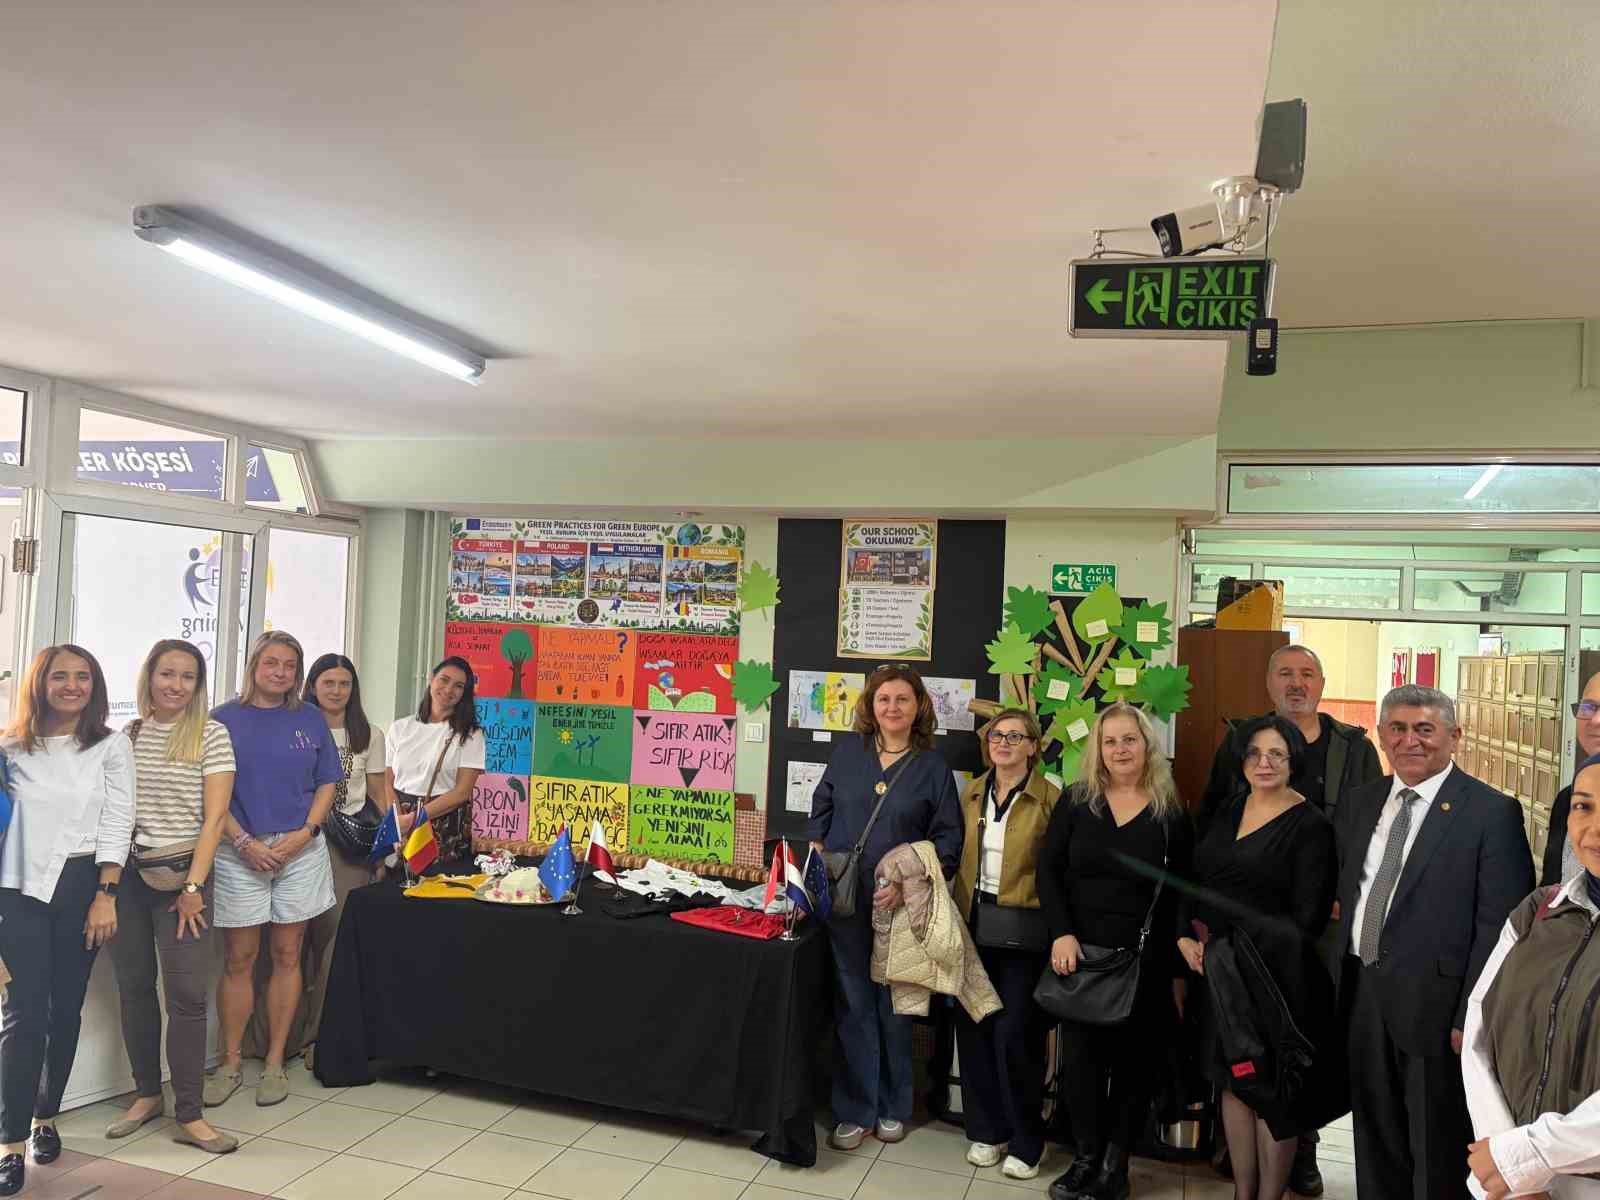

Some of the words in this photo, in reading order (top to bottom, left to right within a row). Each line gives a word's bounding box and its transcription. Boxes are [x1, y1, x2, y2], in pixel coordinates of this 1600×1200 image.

[1178, 266, 1262, 296] EXIT
[111, 446, 194, 479] KÖŞESİ
[527, 520, 552, 529] GREEN
[554, 520, 592, 531] PRACTICES
[593, 522, 606, 531] FOR
[608, 522, 632, 532] GREEN
[634, 522, 659, 532] EUROPE
[861, 527, 880, 536] OUR
[882, 527, 920, 536] SCHOOL
[865, 537, 914, 545] OKULUMUZ
[618, 545, 657, 554] NETHERLANDS
[652, 722, 689, 741] SIFIR
[649, 746, 695, 767] SIFIR
[535, 781, 578, 801] SIFIR
[579, 784, 618, 805] ATIK
[646, 787, 668, 799] NE
